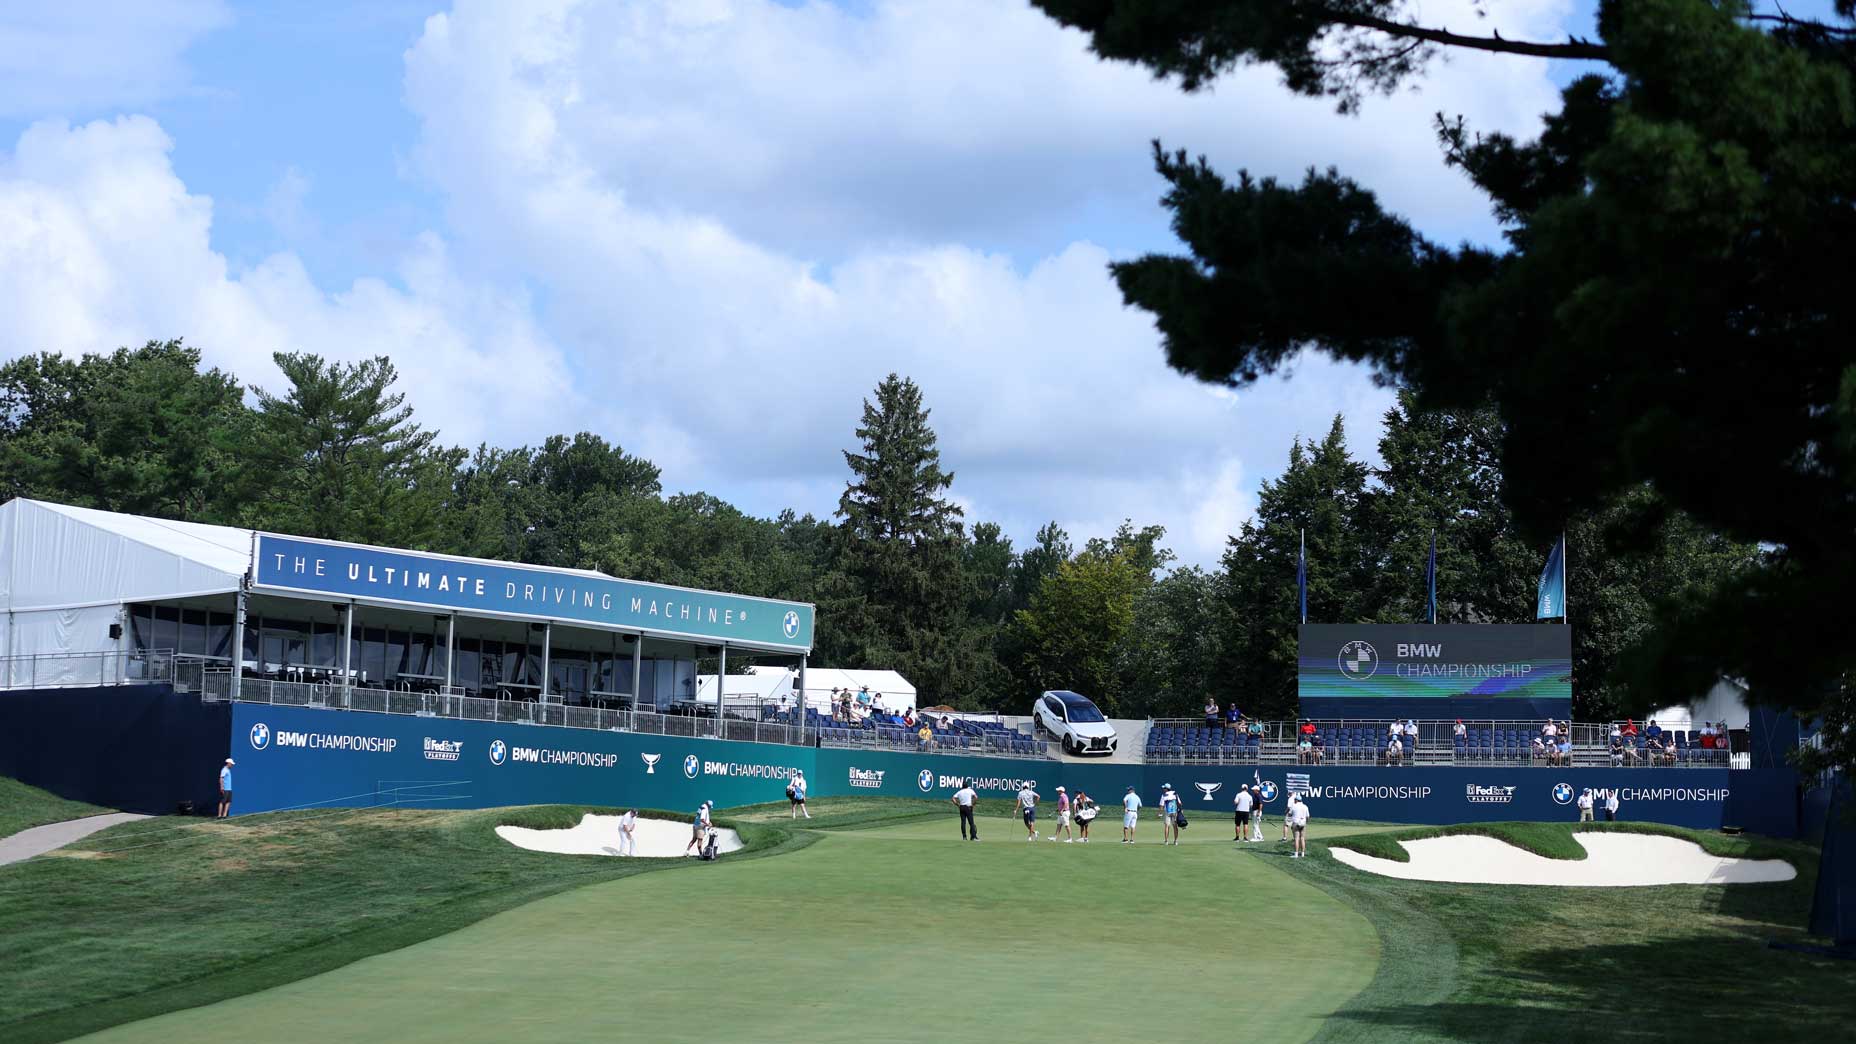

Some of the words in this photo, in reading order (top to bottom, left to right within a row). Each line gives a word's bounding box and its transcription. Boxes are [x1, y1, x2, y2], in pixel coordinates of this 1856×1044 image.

[274, 553, 325, 577] THE
[348, 562, 485, 596] ULTIMATE
[506, 582, 611, 610] DRIVING
[1397, 643, 1442, 658] BMW
[1396, 663, 1532, 678] CHAMPIONSHIP
[276, 731, 308, 748] BMW
[309, 733, 397, 753] CHAMPIONSHIP
[431, 739, 454, 752] FedEx
[512, 747, 539, 763] BMW
[540, 749, 618, 768] CHAMPIONSHIP
[704, 761, 728, 776] BMW
[729, 762, 797, 780] CHAMPIONSHIP
[939, 775, 964, 788] BMW
[1325, 786, 1431, 799] CHAMPIONSHIP
[1475, 785, 1505, 795] FedEx
[1588, 787, 1619, 800] MW
[1621, 787, 1730, 801] CHAMPIONSHIP
